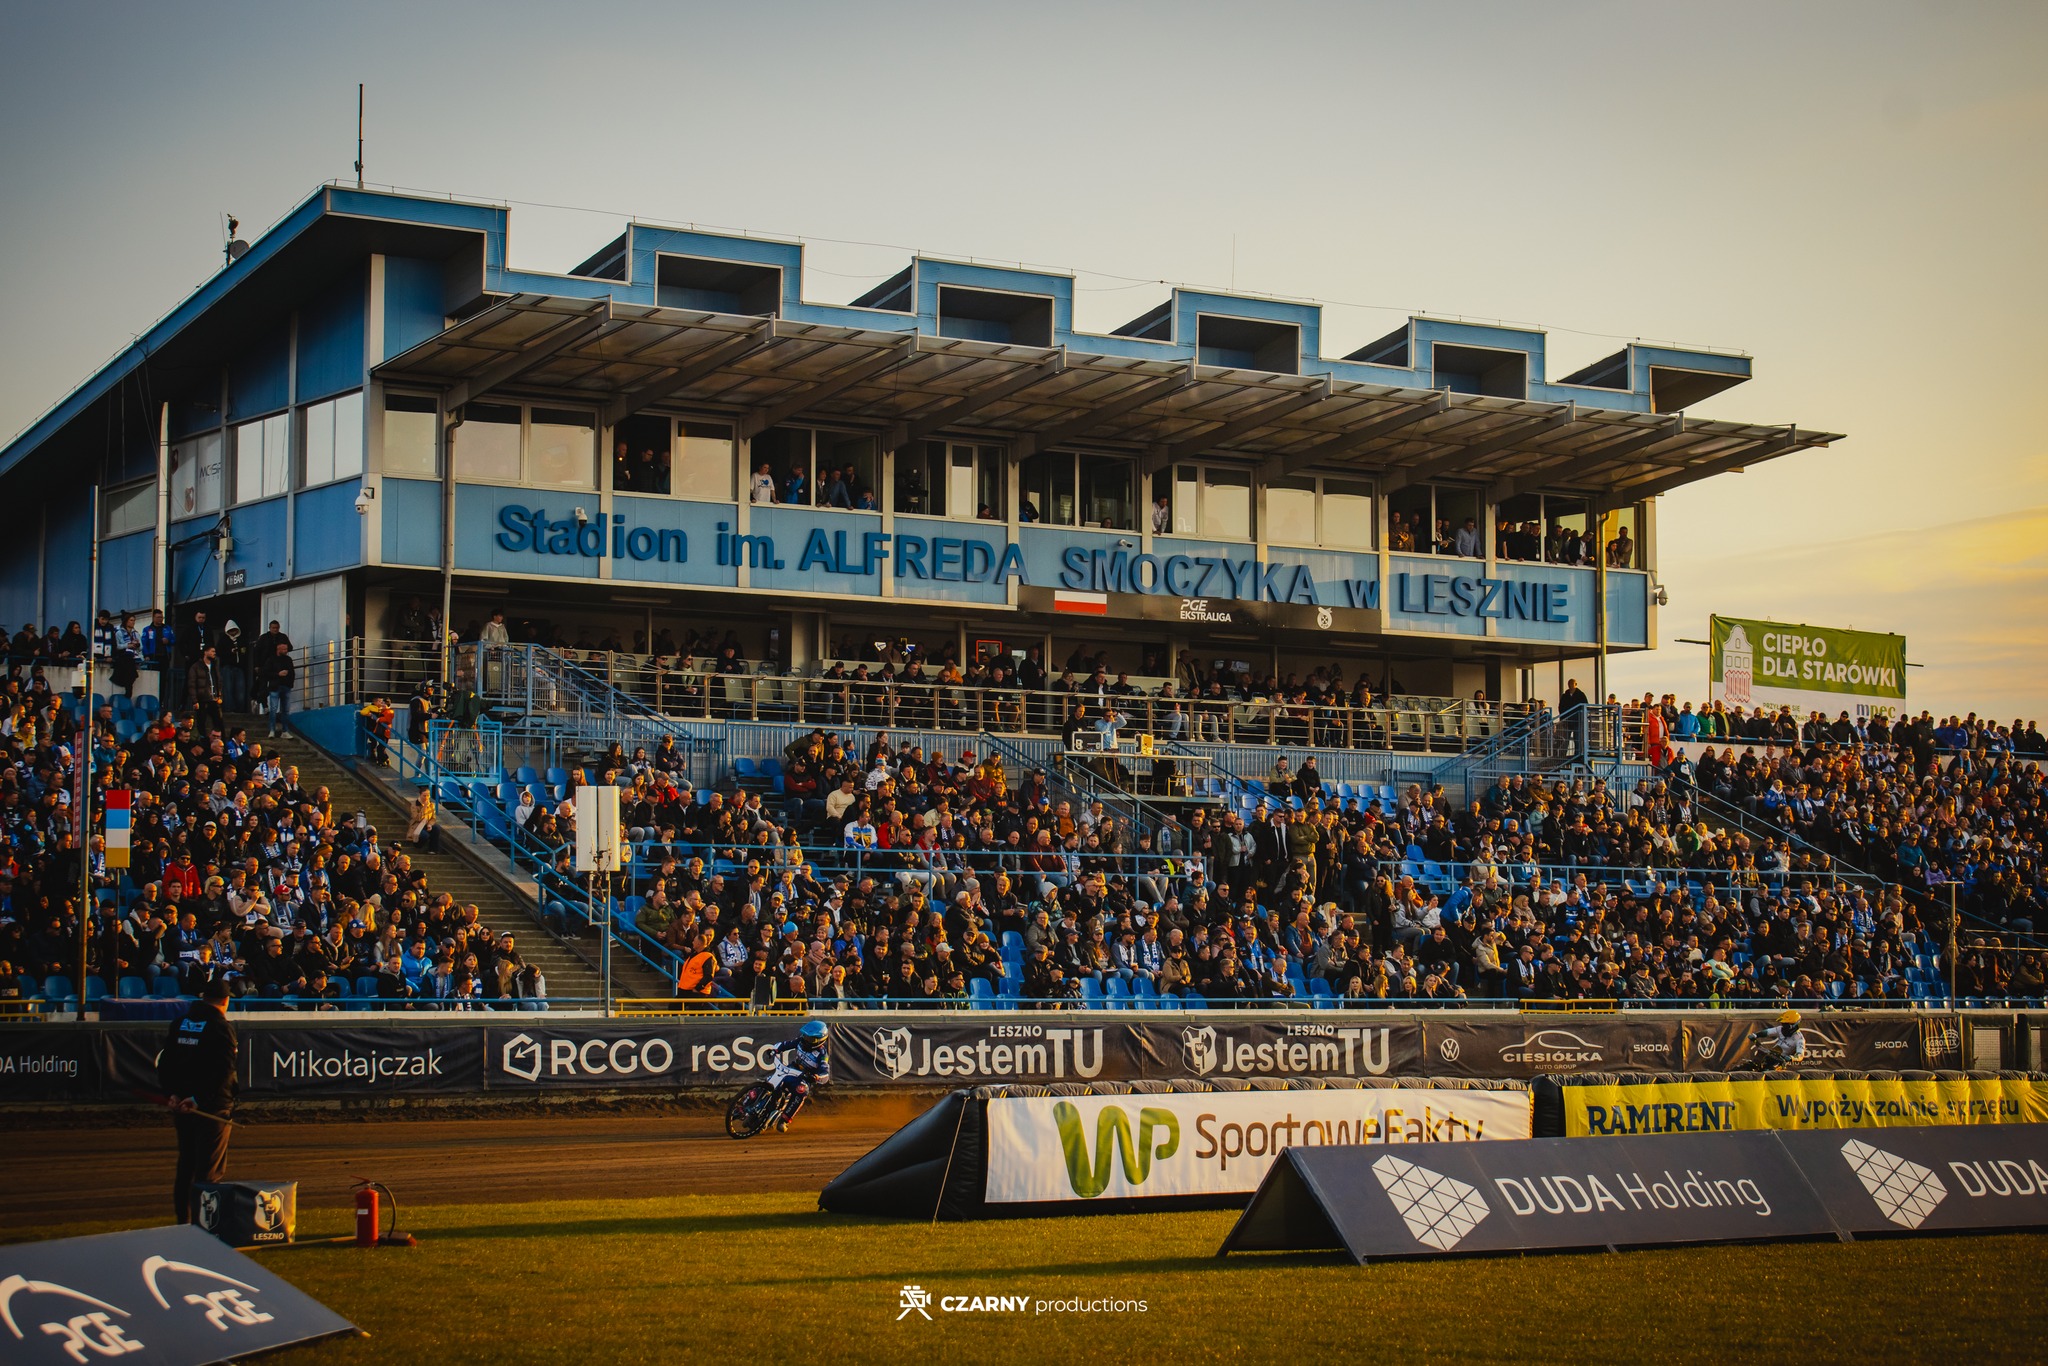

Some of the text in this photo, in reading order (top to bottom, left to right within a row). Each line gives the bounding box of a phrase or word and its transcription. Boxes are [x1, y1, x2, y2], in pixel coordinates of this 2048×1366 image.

[496, 503, 1570, 623] Stadion im. ALFREDA SMOCZYKA w LESZNIE
[1180, 599, 1208, 612] PGE
[1180, 610, 1232, 623] EKSTRALIGA
[1762, 633, 1827, 657] CIEPŁO
[1763, 656, 1896, 687] DLA STARÓWKI
[1856, 703, 1896, 720] mpec
[990, 1025, 1042, 1038] LESZNO
[1287, 1024, 1335, 1036] LESZNO
[20, 1055, 78, 1078] Holding
[273, 1048, 443, 1083] Mikołajczak
[550, 1038, 674, 1075] RCGO
[1502, 1050, 1603, 1062] CIESIÓŁKA
[1587, 1101, 1736, 1135] RAMIRENT
[1775, 1093, 2019, 1124] Wypożyczalnie sprzętu
[1052, 1101, 1181, 1198] WP
[1495, 1169, 1773, 1216] DUDA Holding
[1947, 1160, 2048, 1197] DUDA
[253, 1232, 285, 1240] LESZNO
[182, 1289, 275, 1332] PGE
[39, 1312, 145, 1364] PGE
